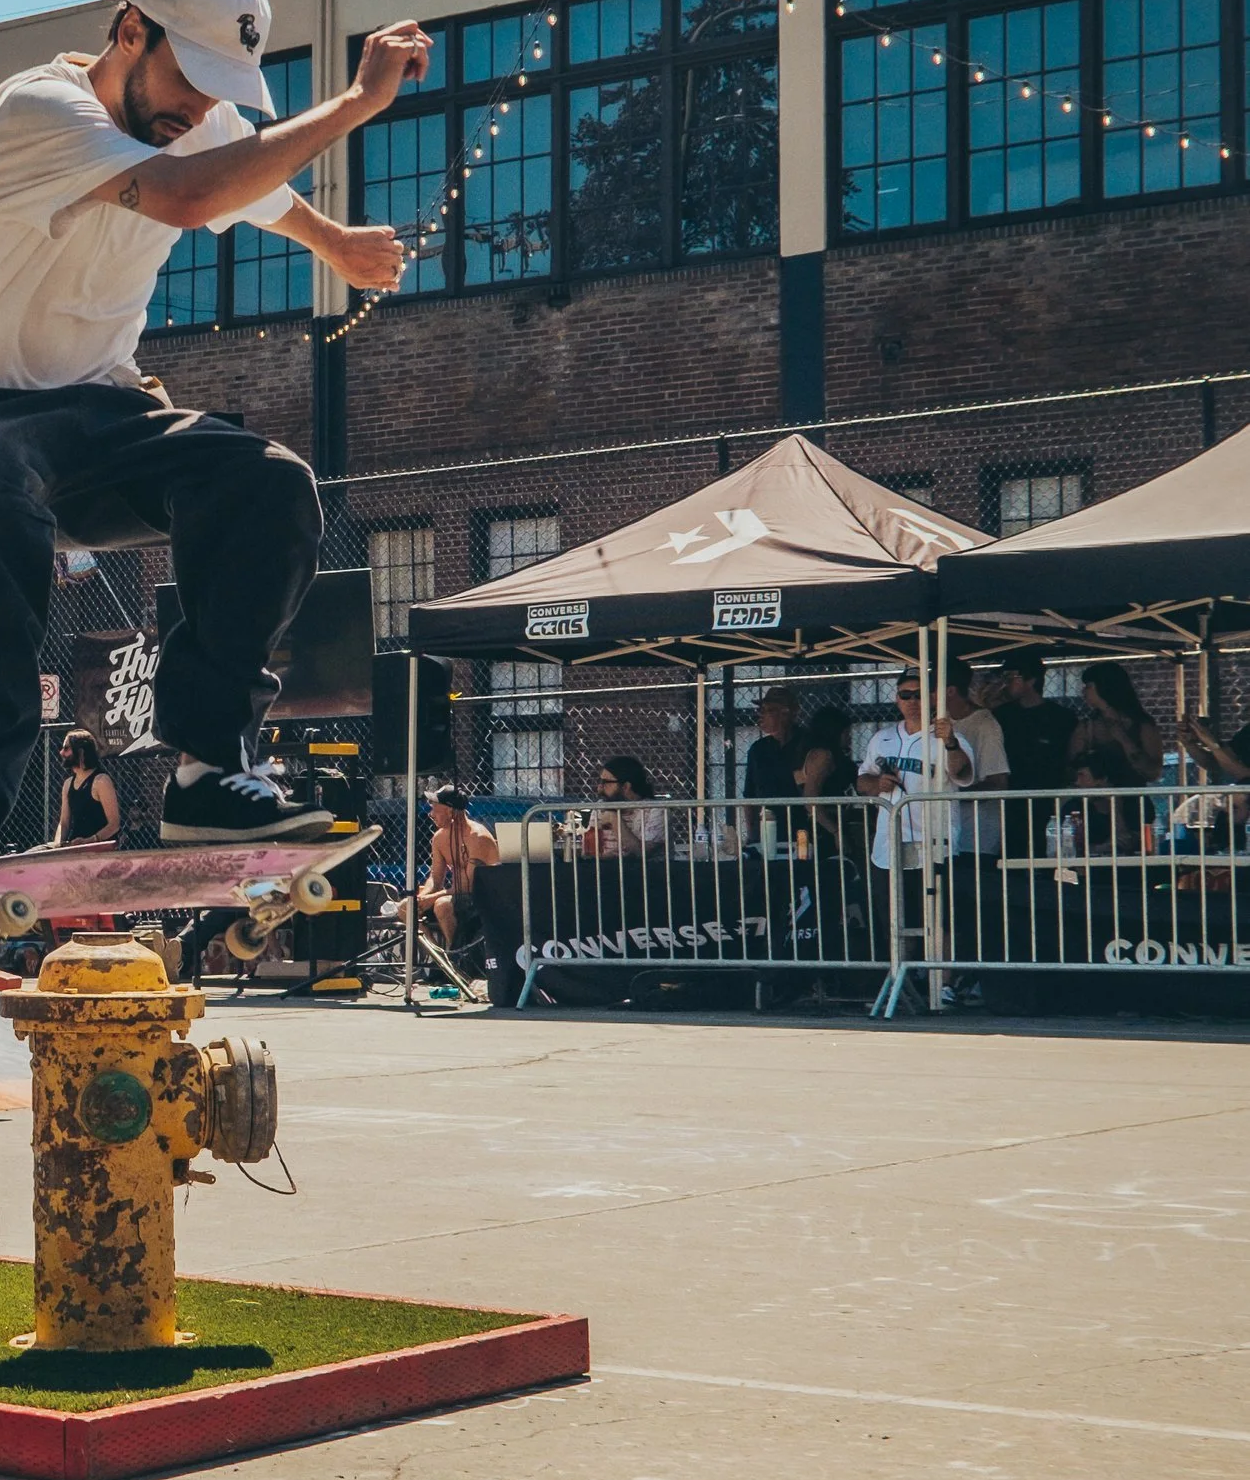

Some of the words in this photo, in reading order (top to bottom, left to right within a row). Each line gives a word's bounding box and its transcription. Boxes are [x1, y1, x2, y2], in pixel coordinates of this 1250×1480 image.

[530, 604, 587, 619] CONVERSE
[717, 592, 778, 604] CONVERSE
[109, 631, 159, 686] Thi
[516, 921, 734, 970] CONVERSE
